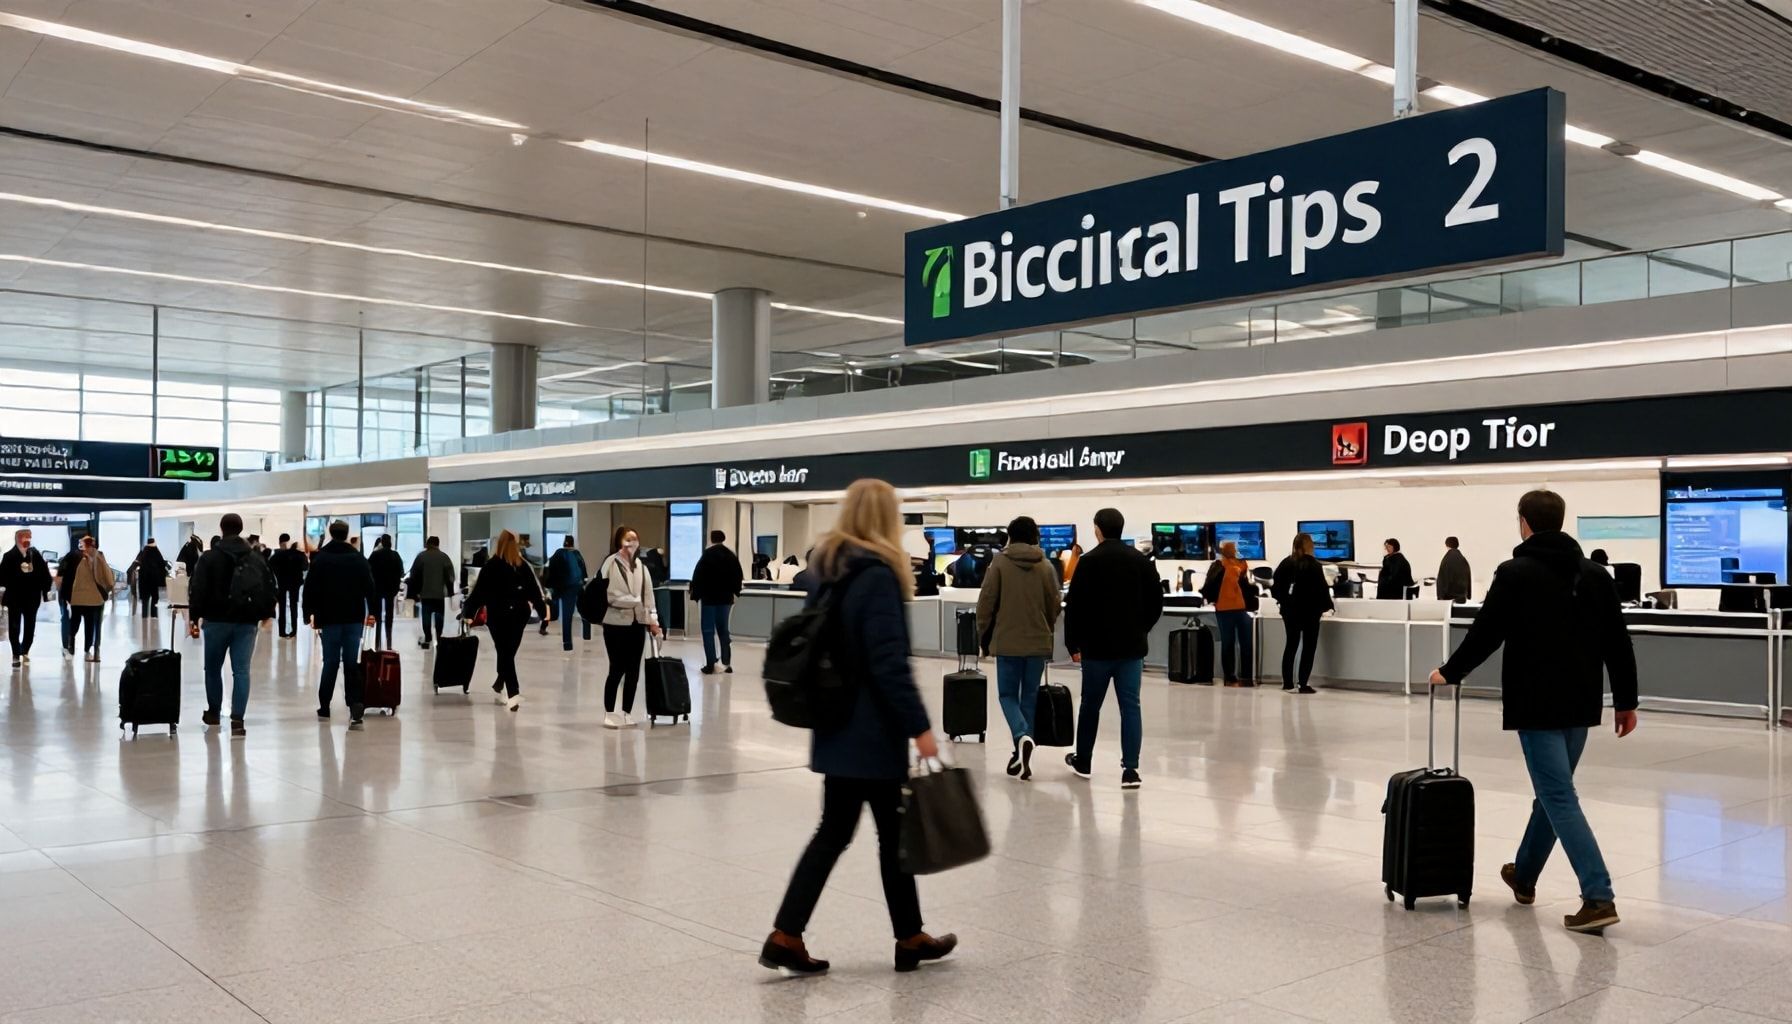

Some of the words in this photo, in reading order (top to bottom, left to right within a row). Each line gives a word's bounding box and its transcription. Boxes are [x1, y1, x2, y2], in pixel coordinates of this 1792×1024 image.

[1219, 174, 1382, 276] Tips
[1444, 137, 1500, 228] 2
[1383, 424, 1471, 460] Deop
[1481, 416, 1556, 450] Tior
